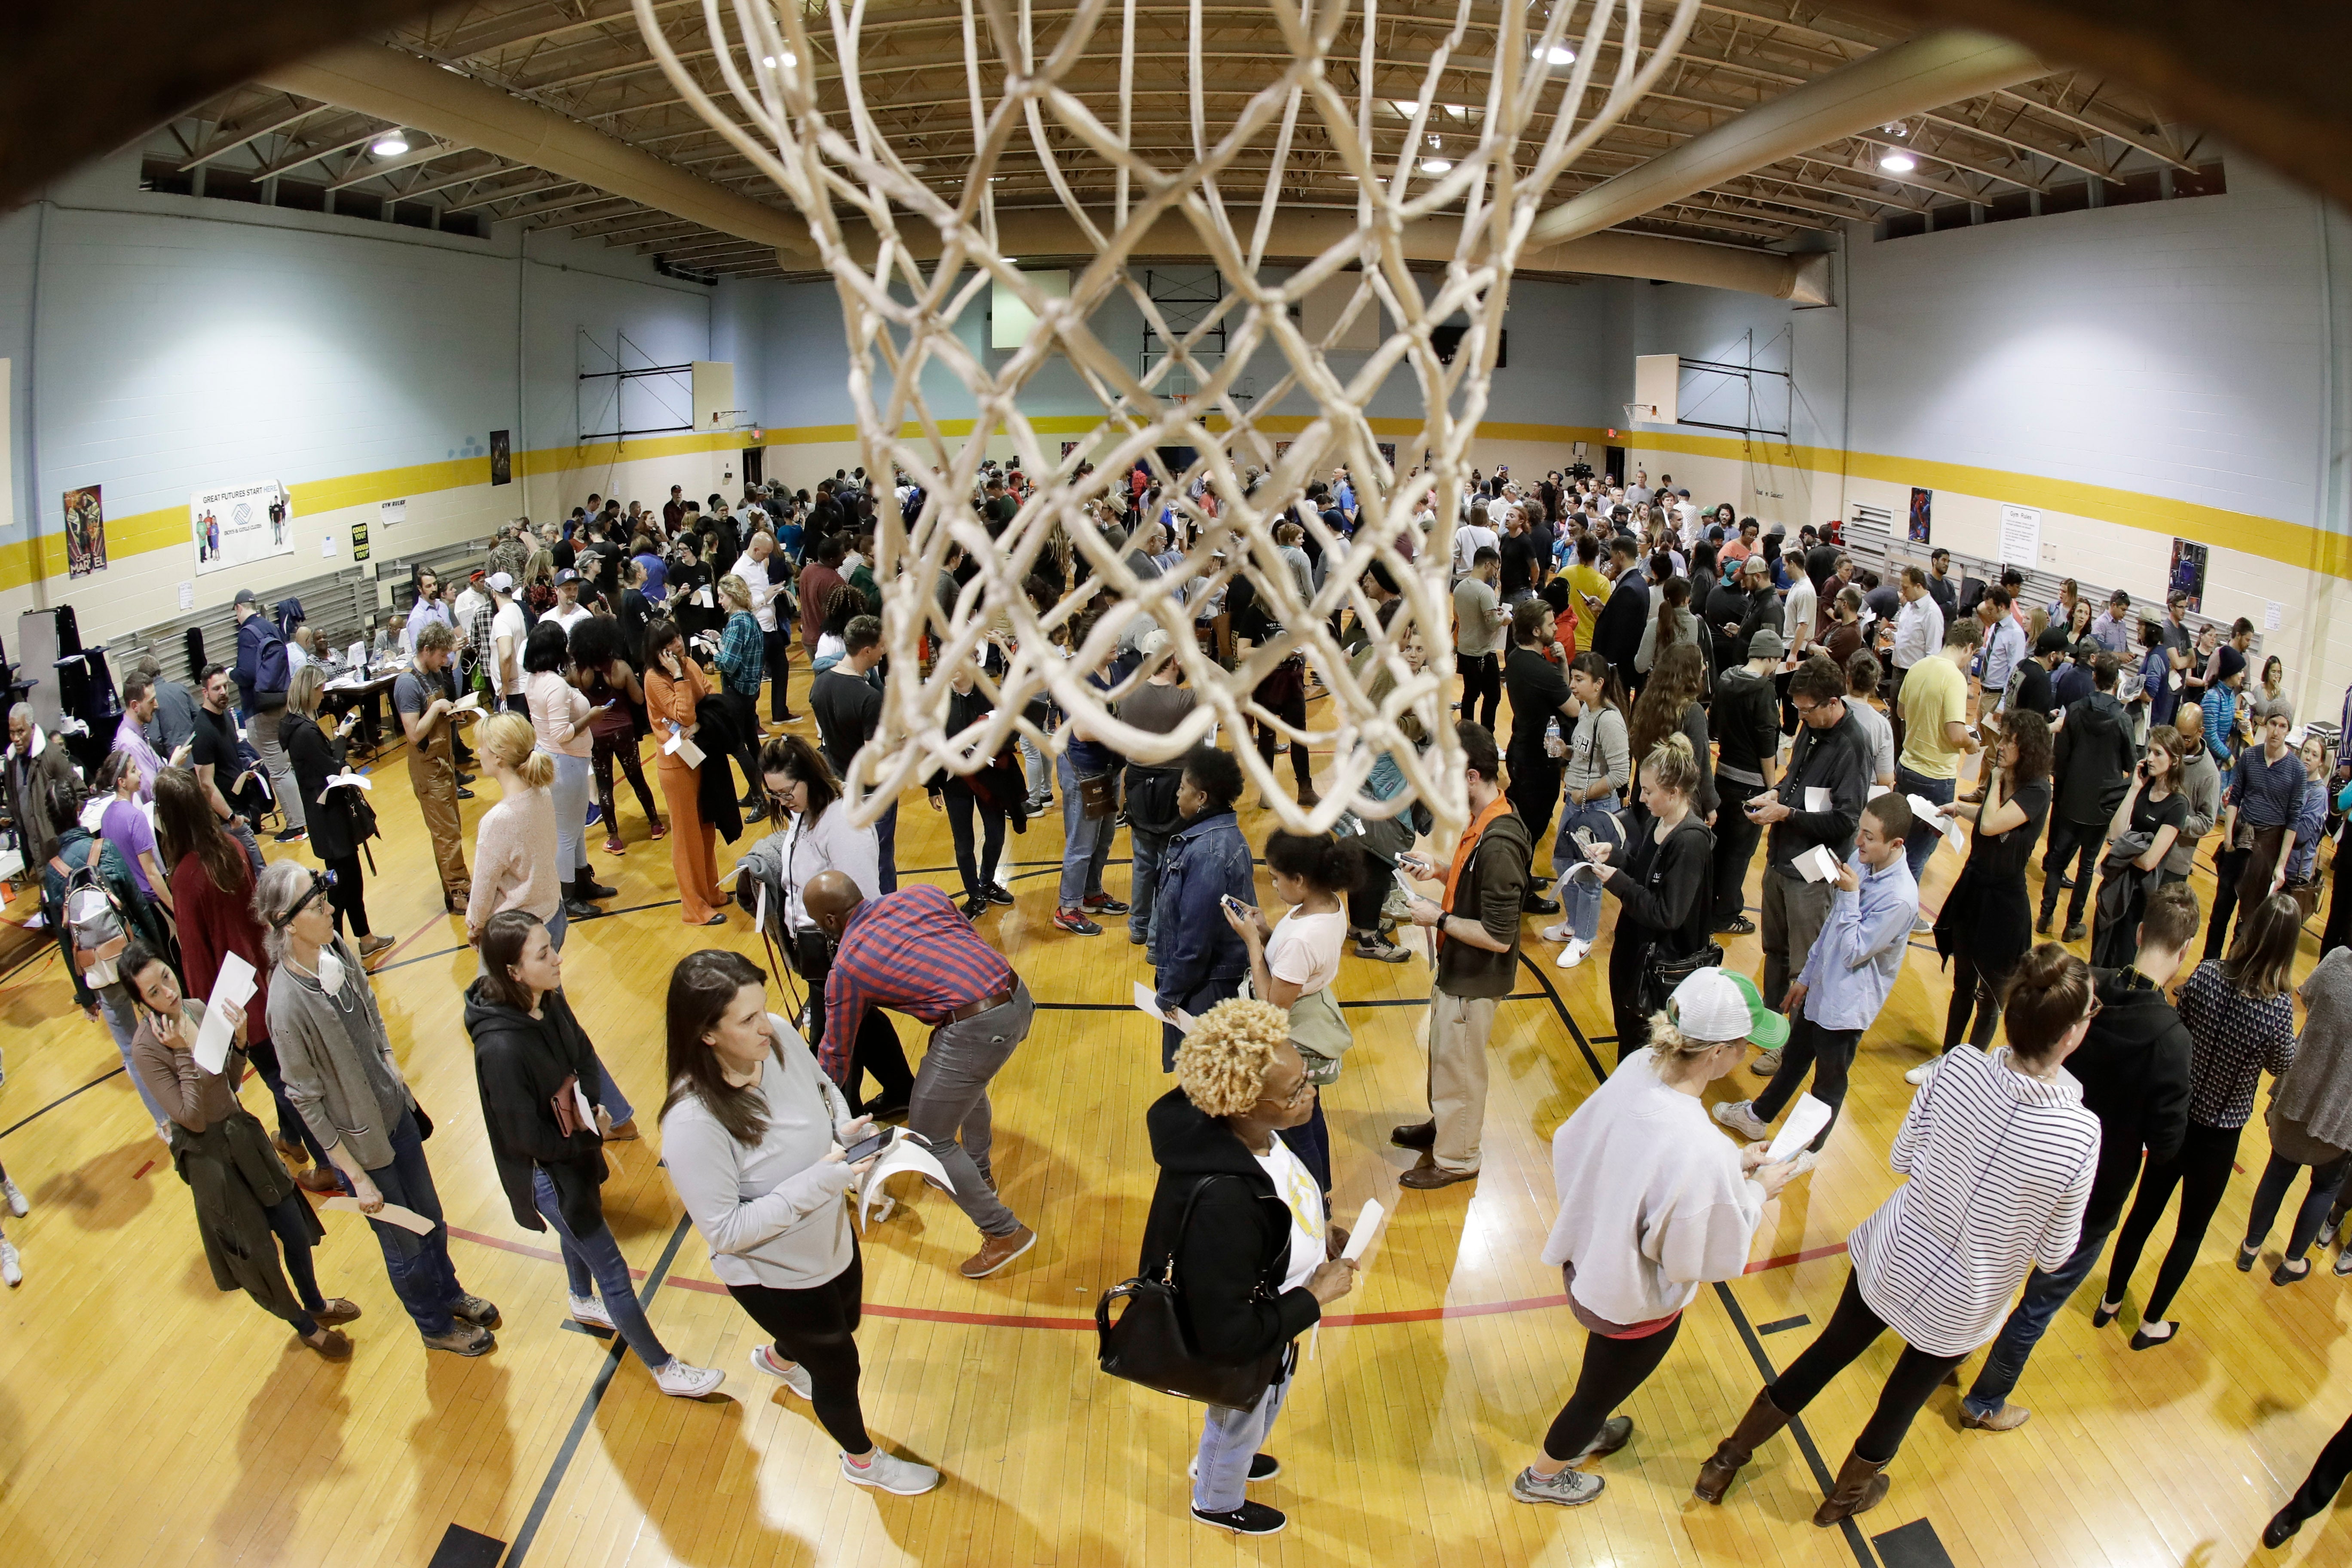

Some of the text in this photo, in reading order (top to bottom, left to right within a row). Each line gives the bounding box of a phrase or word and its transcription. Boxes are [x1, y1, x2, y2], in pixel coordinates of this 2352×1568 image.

[203, 494, 220, 503] GREAT
[221, 490, 245, 500] FUTURES
[247, 487, 263, 496] START
[353, 525, 367, 534] COULD
[355, 532, 366, 540] YOU?
[354, 543, 369, 552] SHOULD
[356, 549, 369, 559] YOU?
